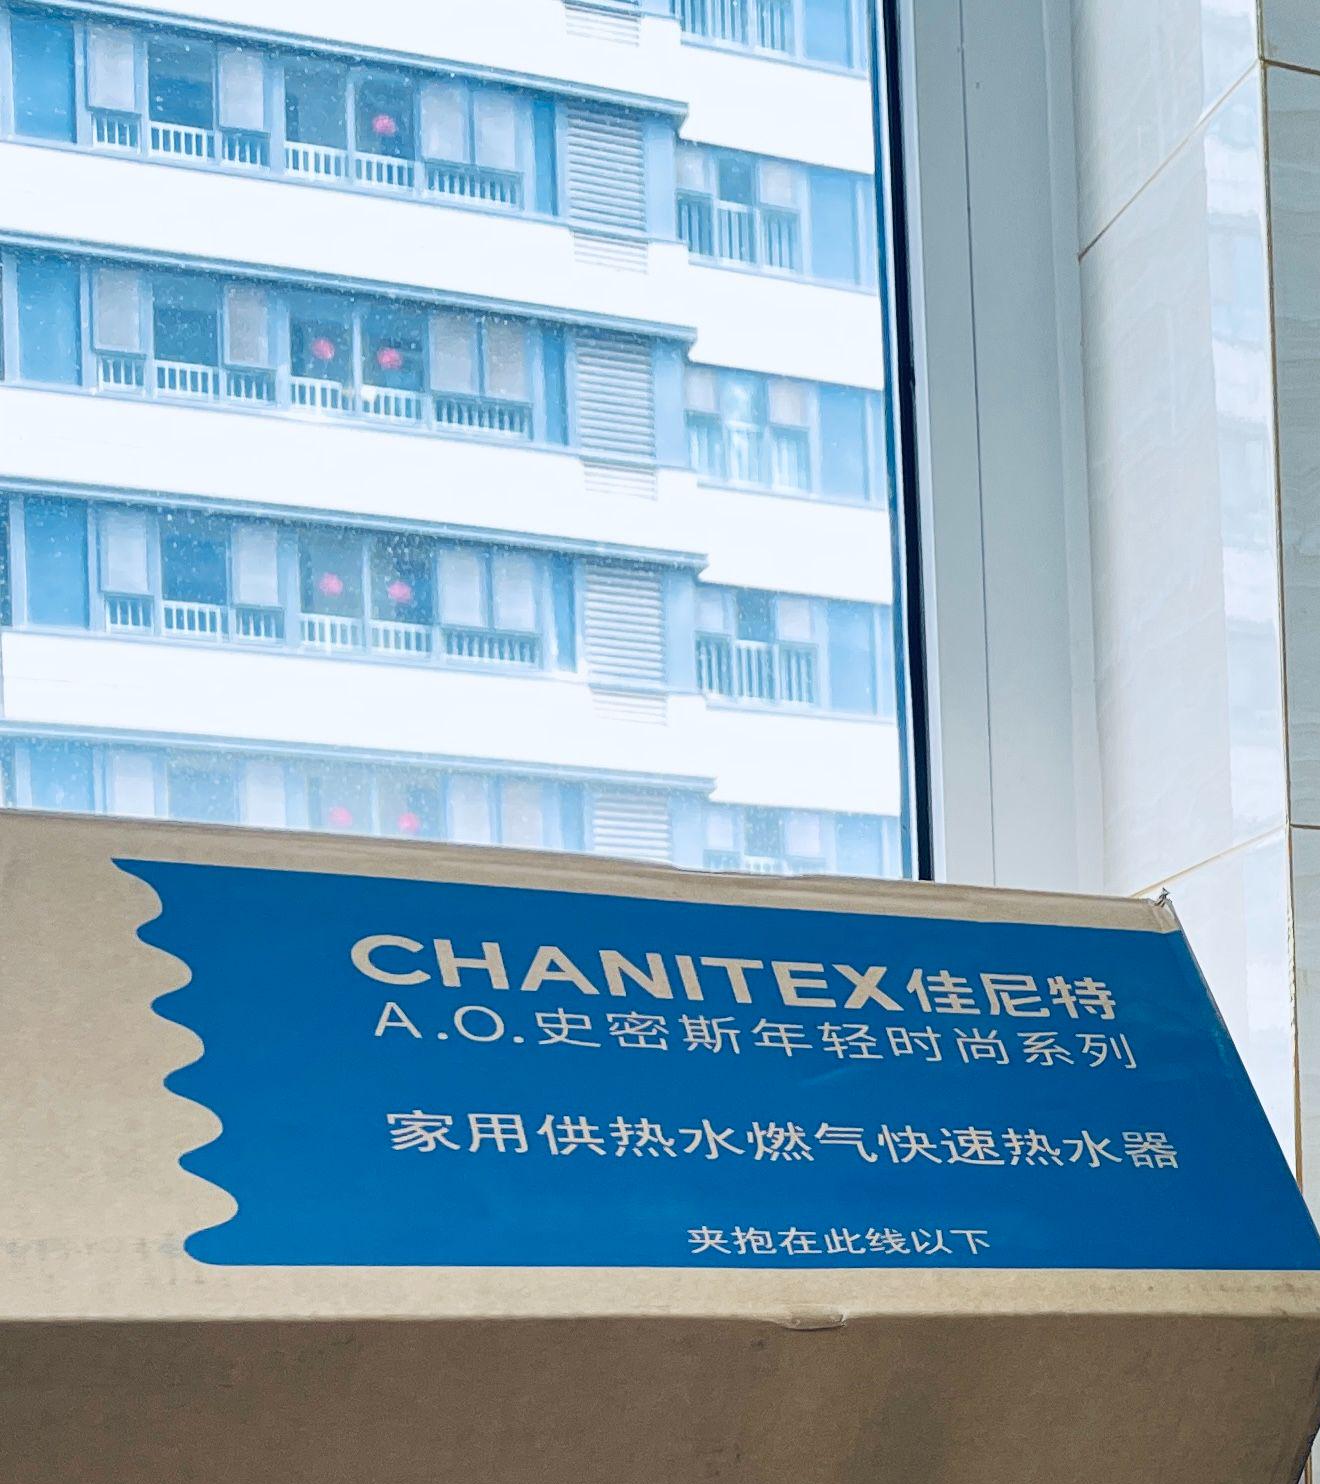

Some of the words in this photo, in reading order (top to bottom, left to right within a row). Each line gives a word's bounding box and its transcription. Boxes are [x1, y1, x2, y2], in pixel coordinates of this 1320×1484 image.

[386, 1109, 1180, 1170] 家用供热水燃气快速热水器
[688, 1227, 992, 1256] 夹抱在此线以下
